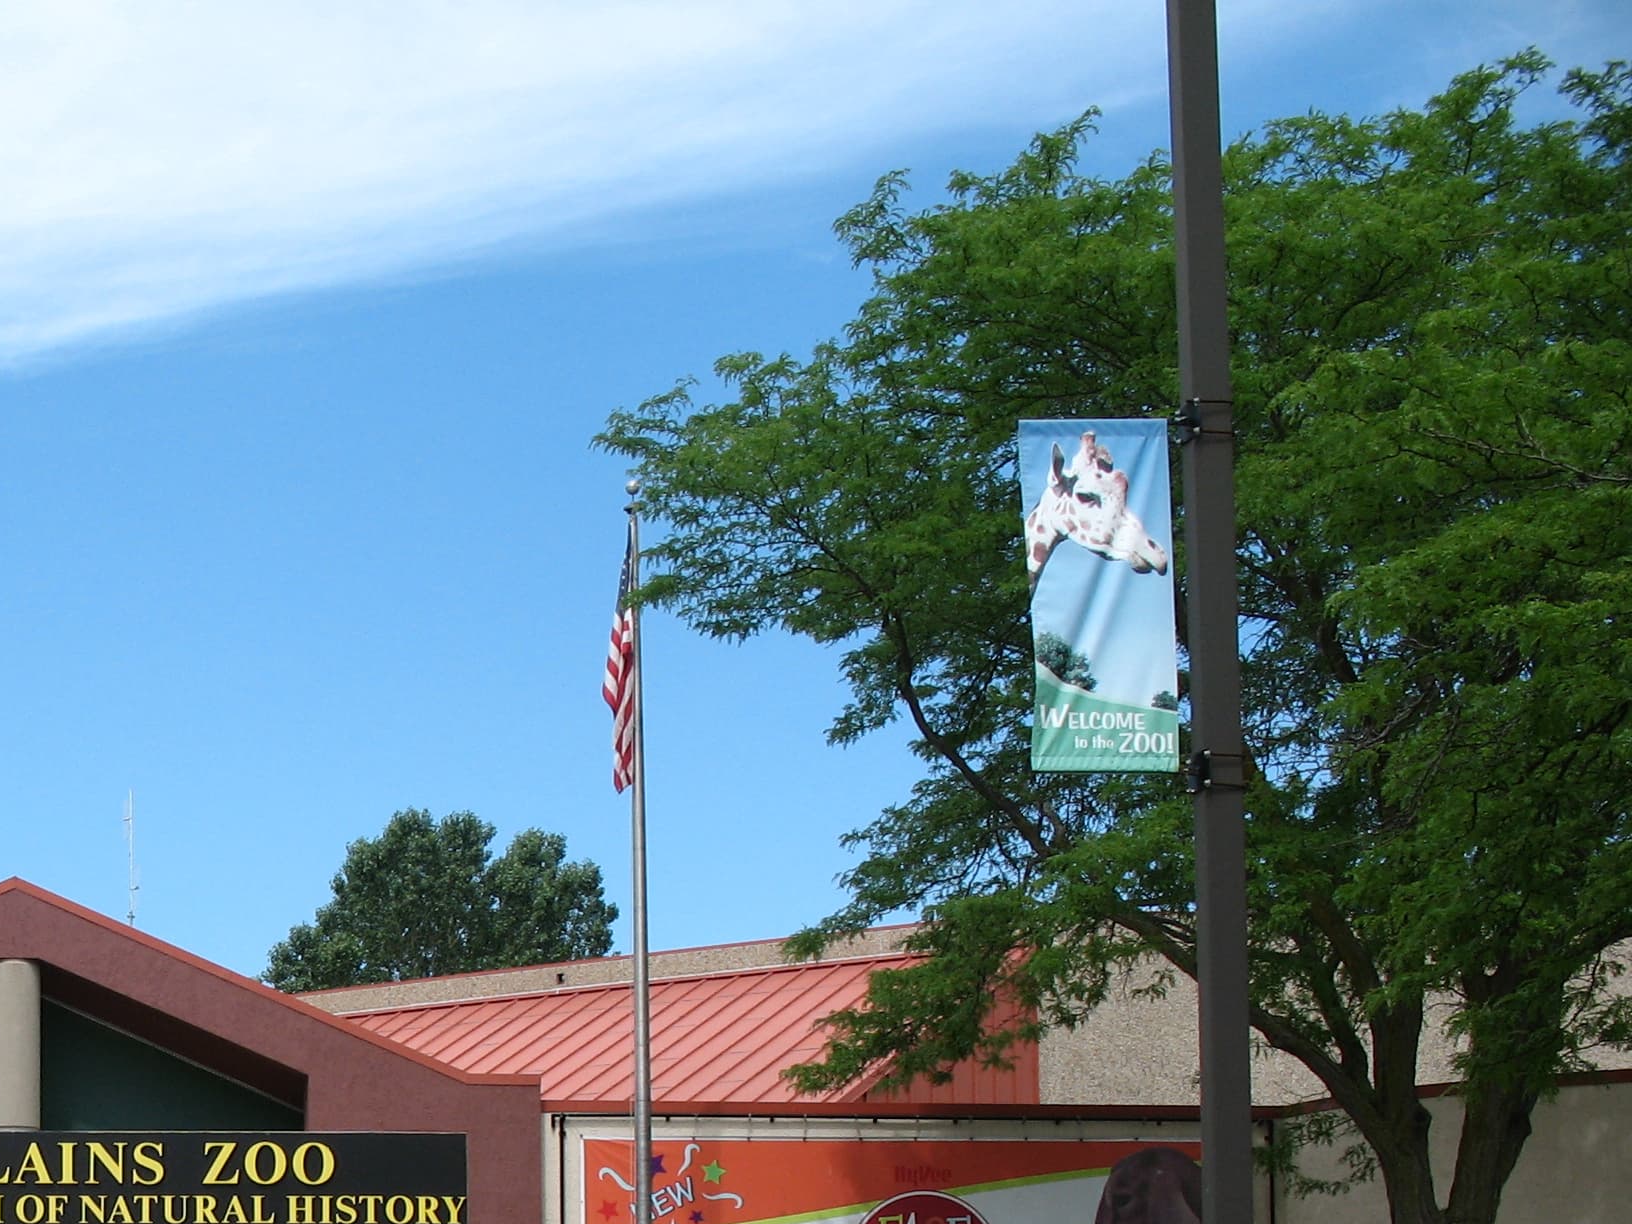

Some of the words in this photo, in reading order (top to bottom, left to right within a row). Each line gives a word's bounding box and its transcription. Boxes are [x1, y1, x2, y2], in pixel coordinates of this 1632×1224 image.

[1039, 703, 1145, 730] WELCOME
[1074, 735, 1088, 749] to
[1091, 735, 1114, 749] the
[1118, 732, 1174, 754] ZOO!
[202, 1141, 335, 1185] ZOO
[15, 1194, 69, 1224] OF
[78, 1194, 275, 1224] NATURAL
